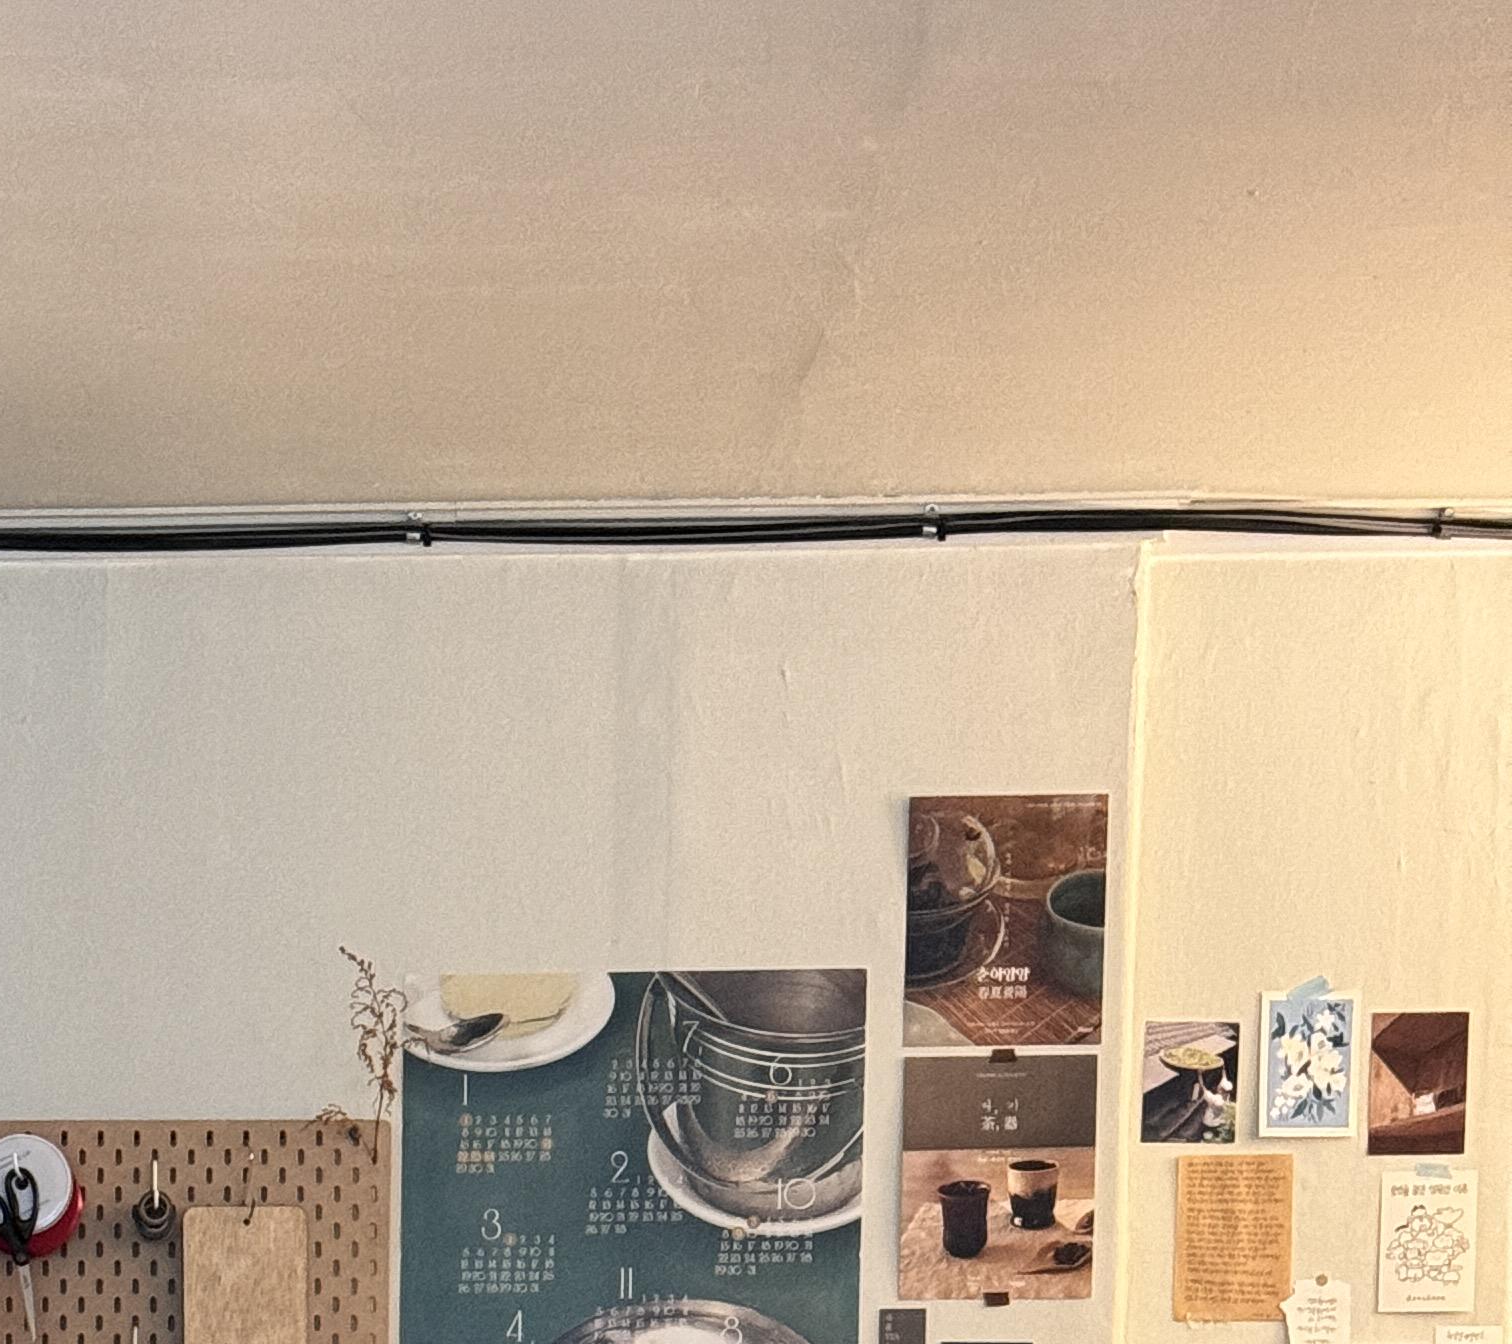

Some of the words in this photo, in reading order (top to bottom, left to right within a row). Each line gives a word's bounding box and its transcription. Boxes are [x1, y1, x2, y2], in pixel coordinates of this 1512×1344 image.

[682, 1021, 699, 1053] 7
[769, 1055, 793, 1086] 6
[462, 1073, 468, 1106] 1
[610, 1150, 630, 1183] 2
[777, 1178, 816, 1210] 10
[481, 1208, 502, 1240] 3
[620, 1267, 633, 1299] 11
[506, 1309, 522, 1342] 4
